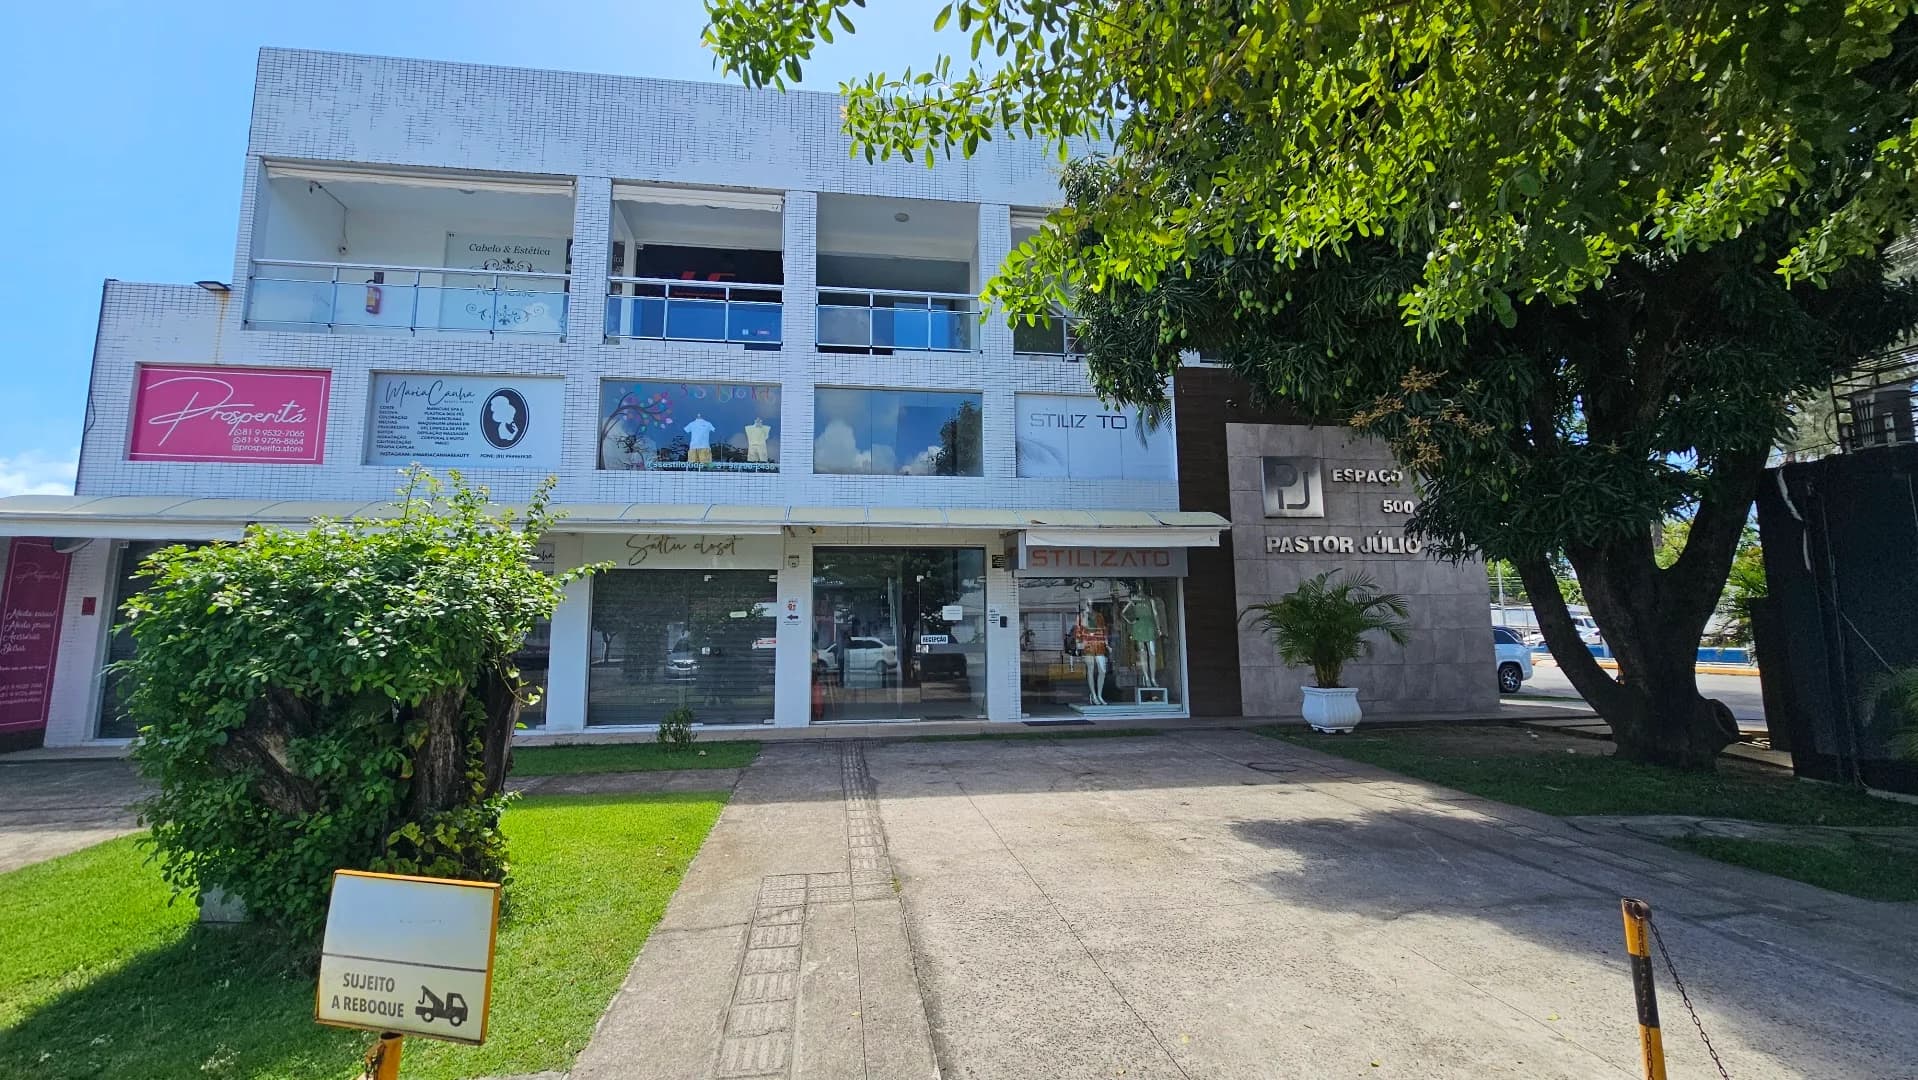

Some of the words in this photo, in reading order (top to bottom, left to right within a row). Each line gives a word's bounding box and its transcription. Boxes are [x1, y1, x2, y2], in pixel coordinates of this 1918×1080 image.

[468, 243, 500, 252] Cabelo
[503, 244, 511, 252] &
[513, 244, 551, 256] Estética
[1332, 468, 1404, 486] ESPAÇO
[1383, 499, 1415, 514] 500
[1266, 535, 1354, 554] PASTOR
[1360, 529, 1422, 554] JÚLIO
[1032, 549, 1171, 568] STILIZATO
[922, 635, 947, 644] RECEPÇÃO
[343, 972, 396, 993] SUJEITO
[331, 994, 340, 1010] A
[343, 996, 404, 1018] REBOQUE
